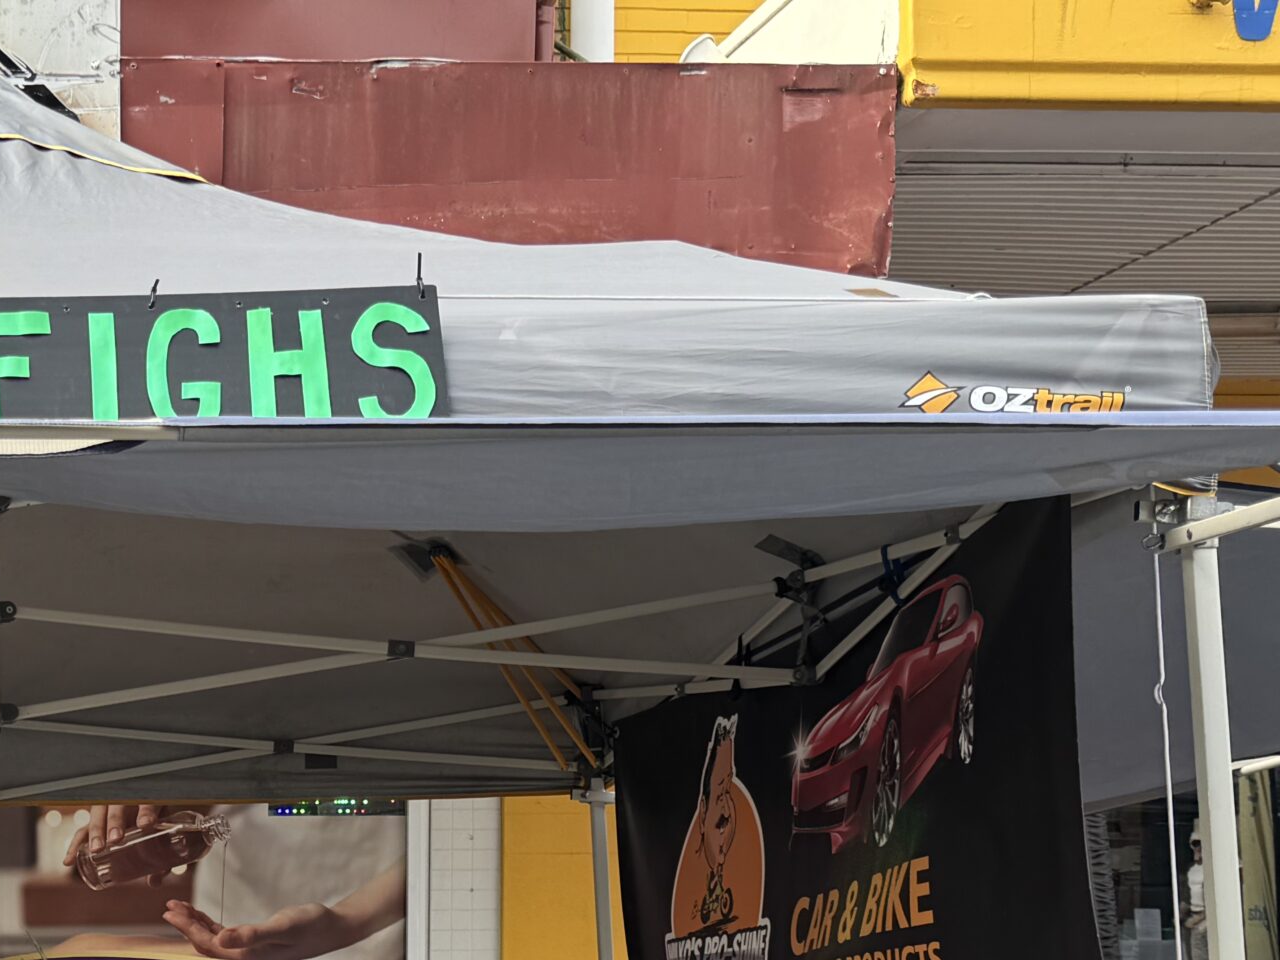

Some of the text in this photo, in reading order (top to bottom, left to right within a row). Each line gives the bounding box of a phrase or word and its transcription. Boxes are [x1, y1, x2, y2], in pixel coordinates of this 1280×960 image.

[790, 856, 934, 956] CAR & BIKE
